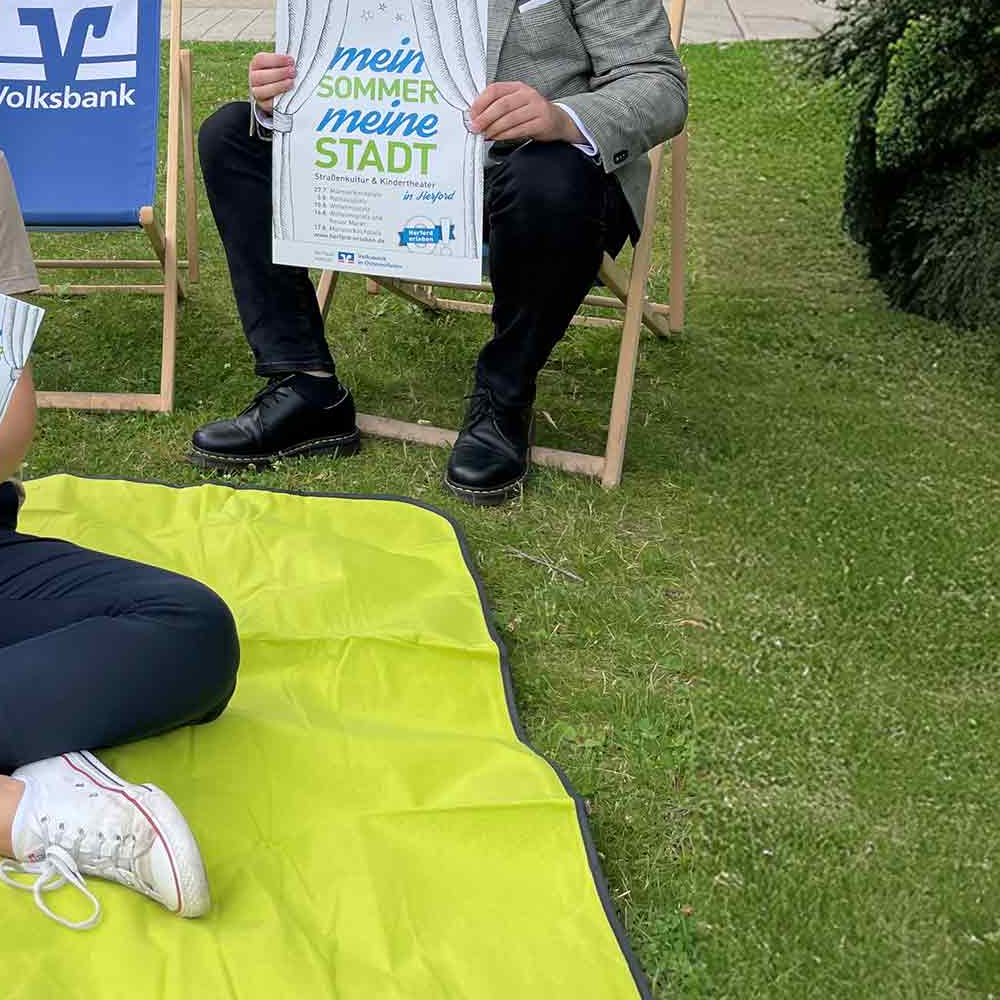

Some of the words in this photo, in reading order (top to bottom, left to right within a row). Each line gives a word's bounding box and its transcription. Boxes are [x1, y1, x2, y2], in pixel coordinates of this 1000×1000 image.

[328, 36, 425, 74] mein
[316, 75, 440, 104] SOMMER
[316, 100, 440, 138] meine
[314, 137, 437, 175] STADT
[314, 173, 369, 185] Straßenkultur
[380, 178, 436, 189] Kindertheater
[402, 190, 413, 200] in
[416, 190, 456, 205] Herford
